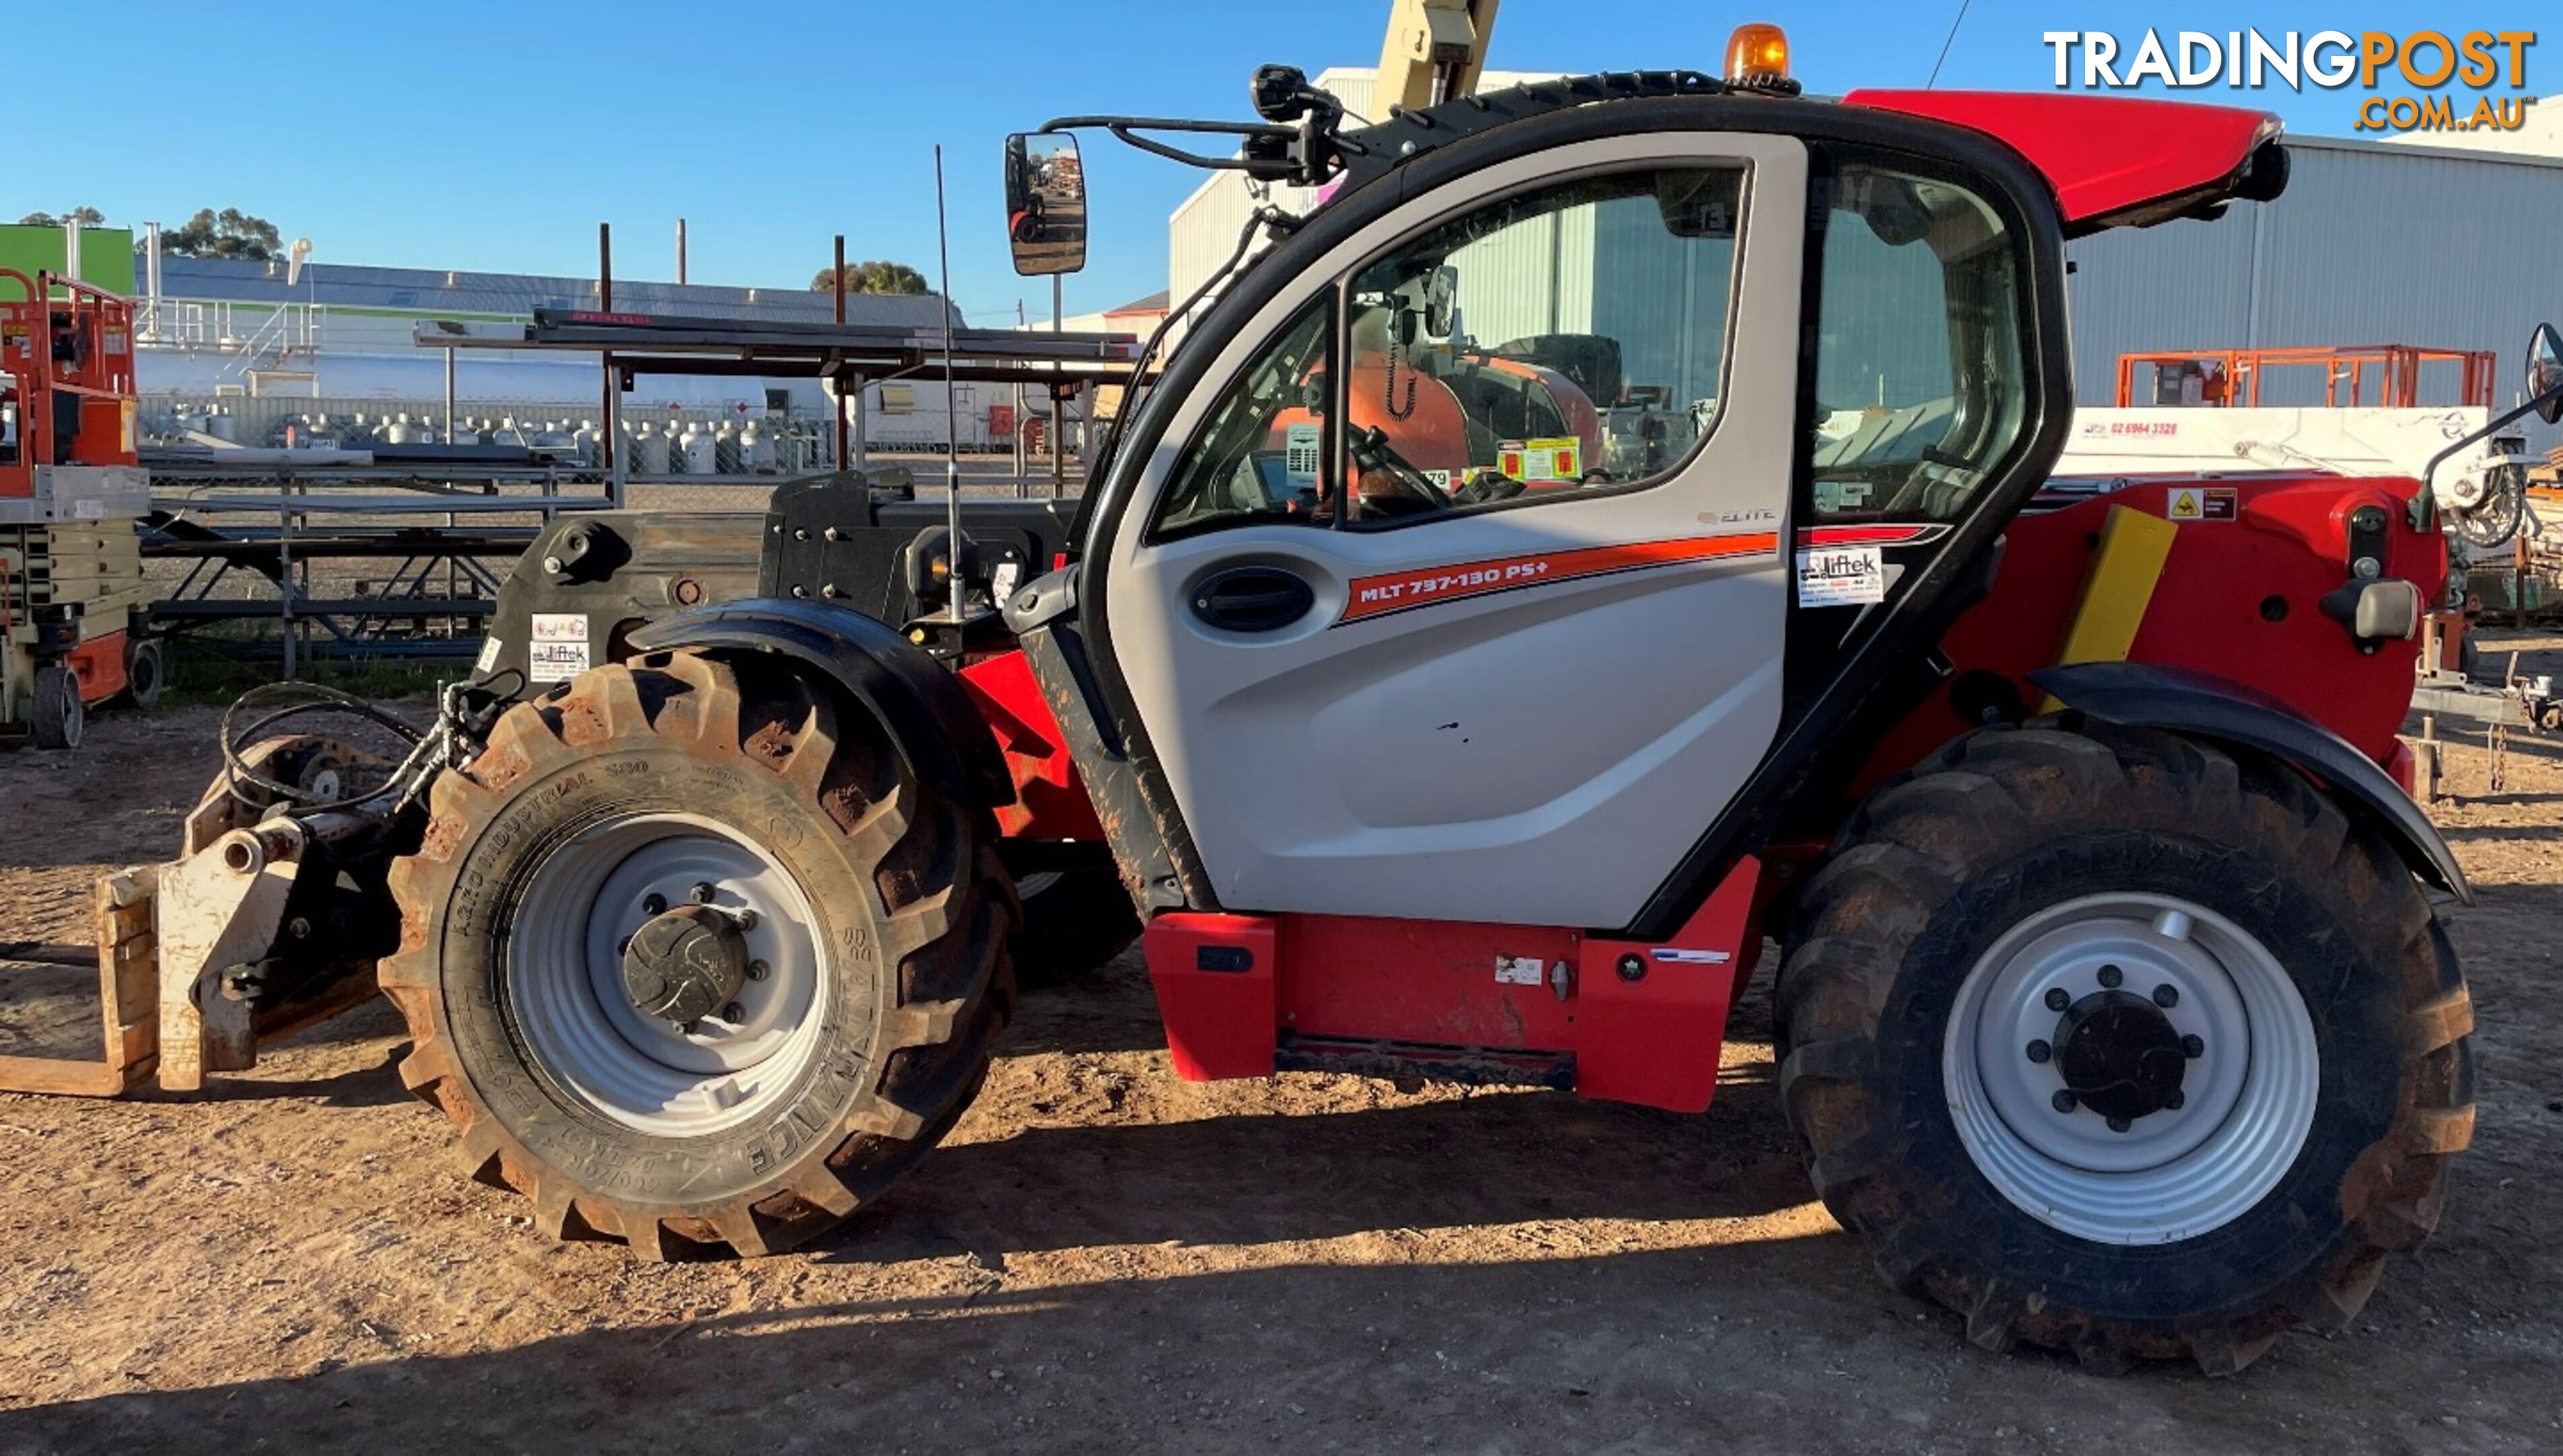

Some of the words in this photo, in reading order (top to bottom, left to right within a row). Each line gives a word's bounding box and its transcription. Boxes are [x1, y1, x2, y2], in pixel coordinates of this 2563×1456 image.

[2111, 423, 2123, 433] 02
[2125, 423, 2150, 435] 6964
[1721, 509, 1776, 523] ELITE
[1361, 583, 1404, 603] MLT
[1410, 569, 1501, 595] 737-130
[1505, 562, 1549, 580] PS+
